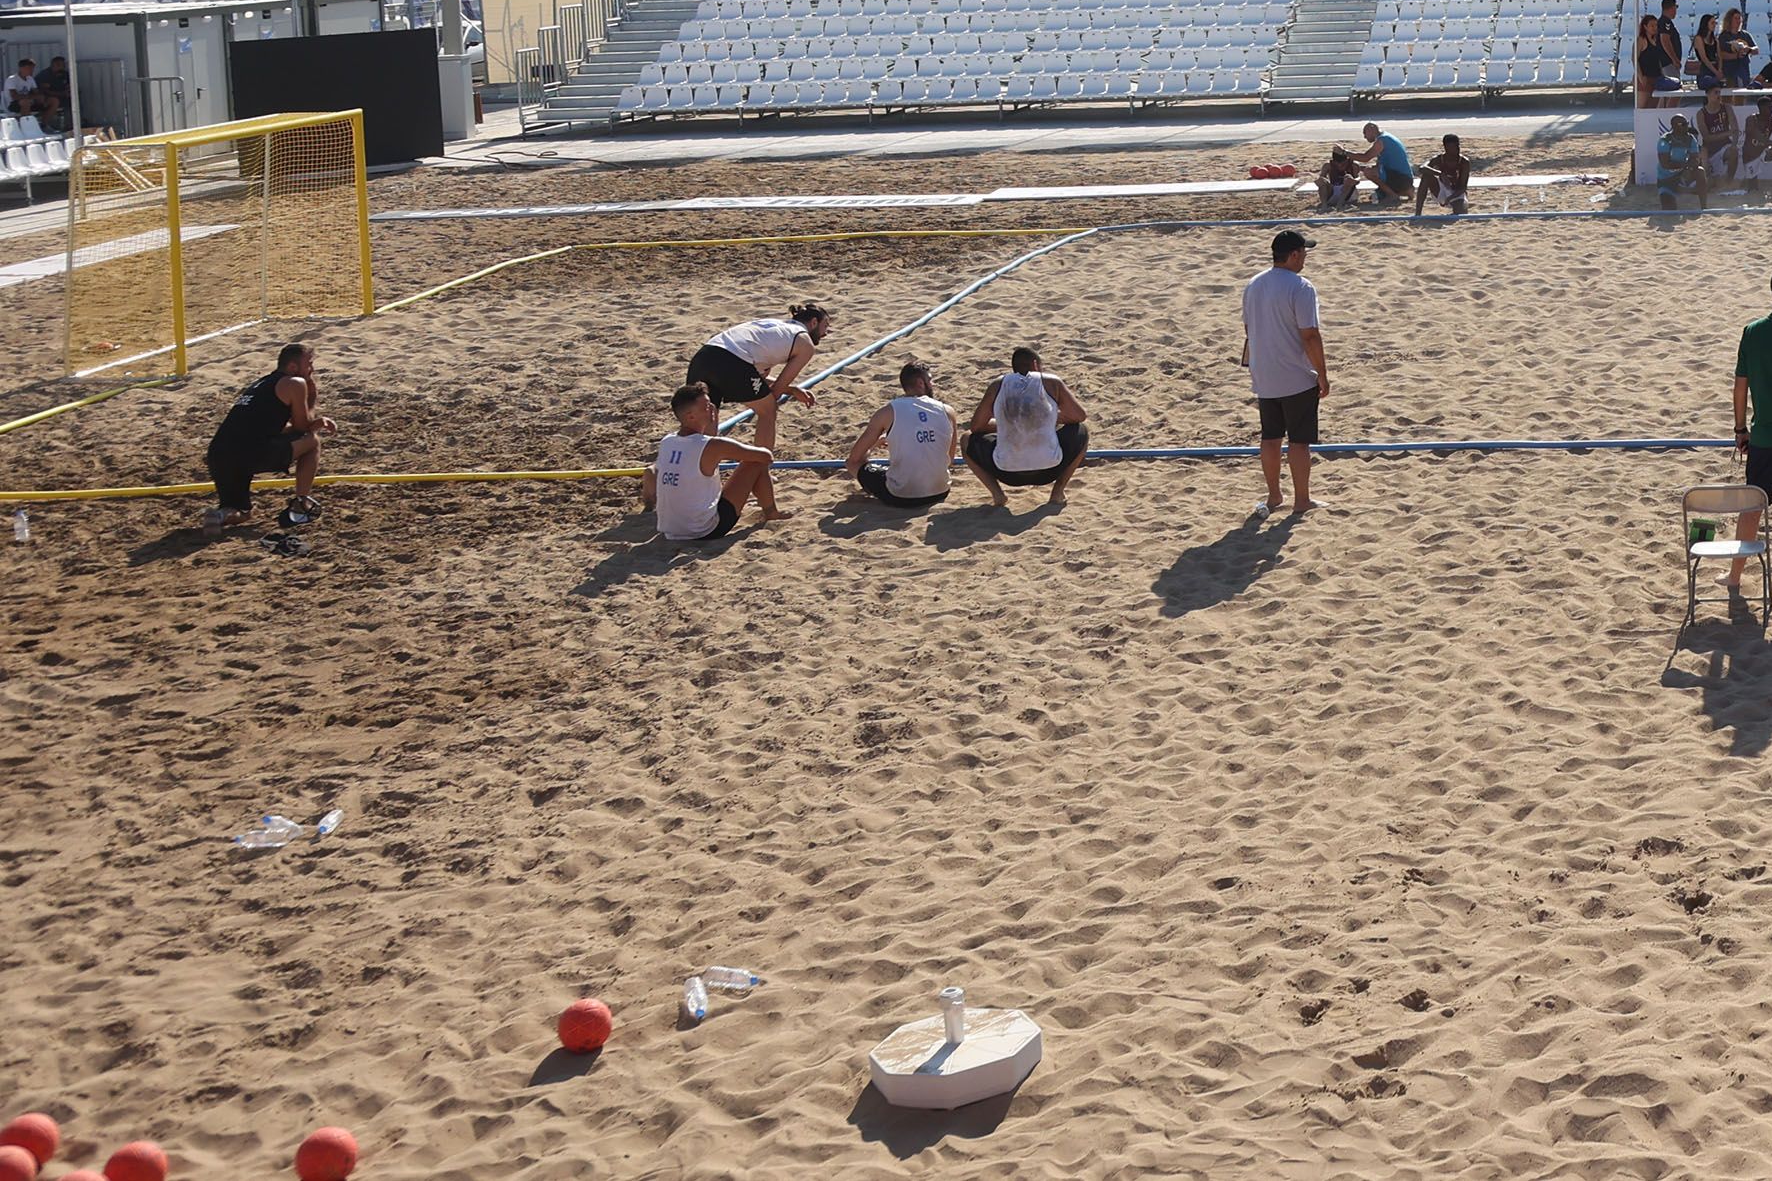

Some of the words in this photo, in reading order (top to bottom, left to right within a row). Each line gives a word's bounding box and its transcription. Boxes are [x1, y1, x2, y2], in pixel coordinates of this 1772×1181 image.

[918, 411, 928, 422] 8
[916, 430, 936, 443] GRE
[669, 450, 682, 465] 11
[662, 472, 680, 486] GRE
